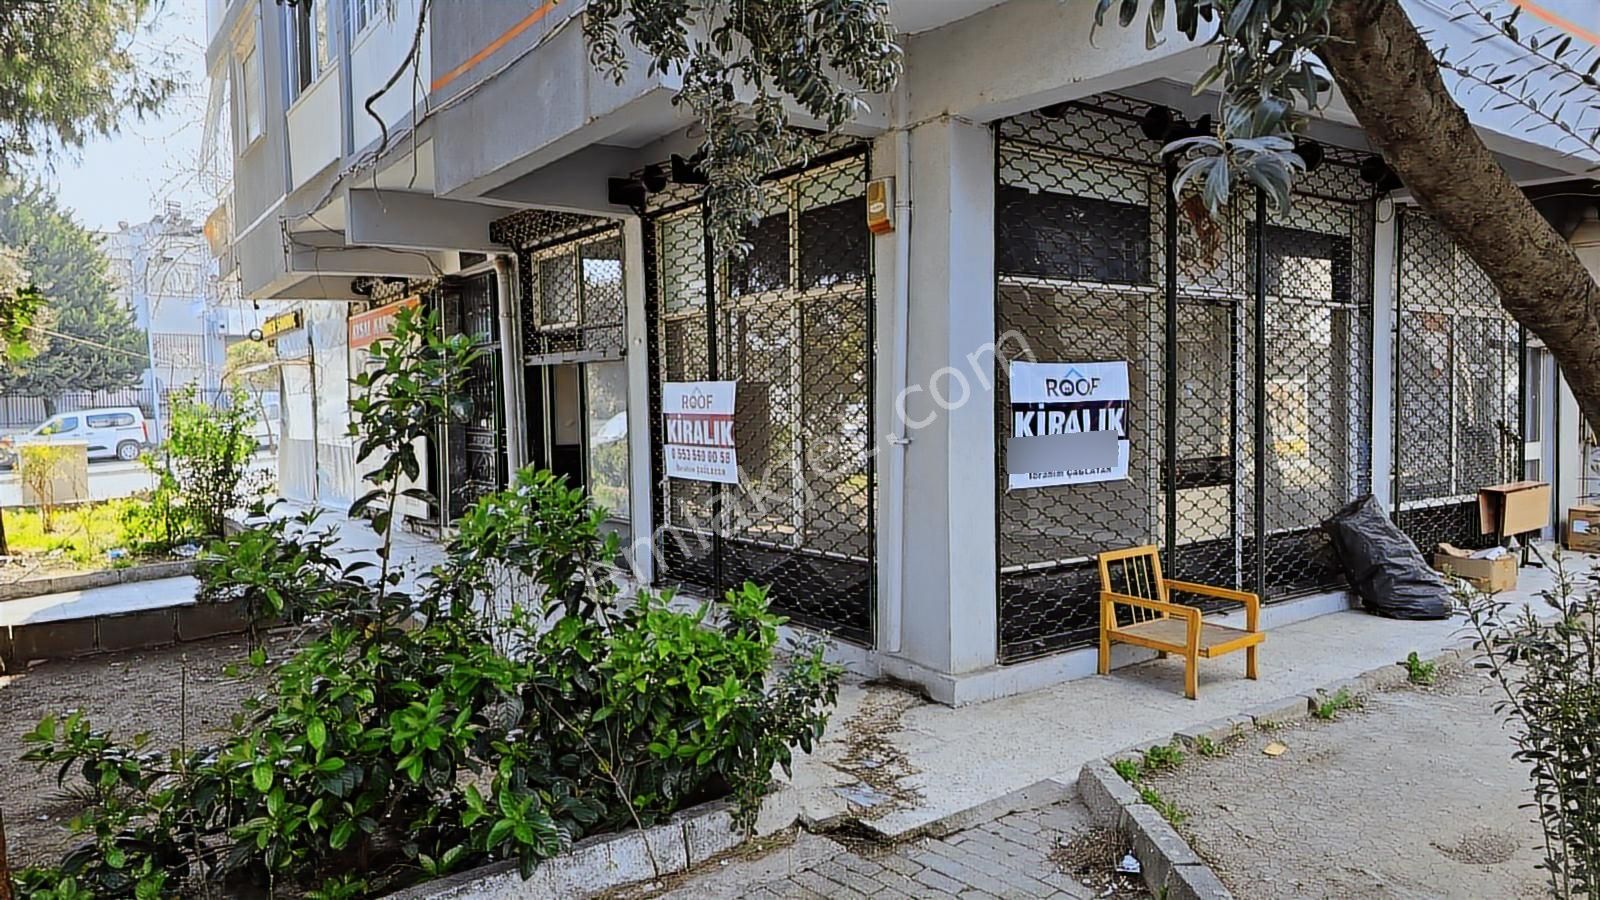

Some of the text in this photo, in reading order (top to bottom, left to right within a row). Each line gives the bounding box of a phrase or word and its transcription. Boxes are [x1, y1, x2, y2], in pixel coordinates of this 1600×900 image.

[1045, 377, 1101, 397] ROOF
[681, 394, 713, 409] ROOF
[666, 415, 735, 446] KİRALIK
[1014, 402, 1126, 438] KİRALIK
